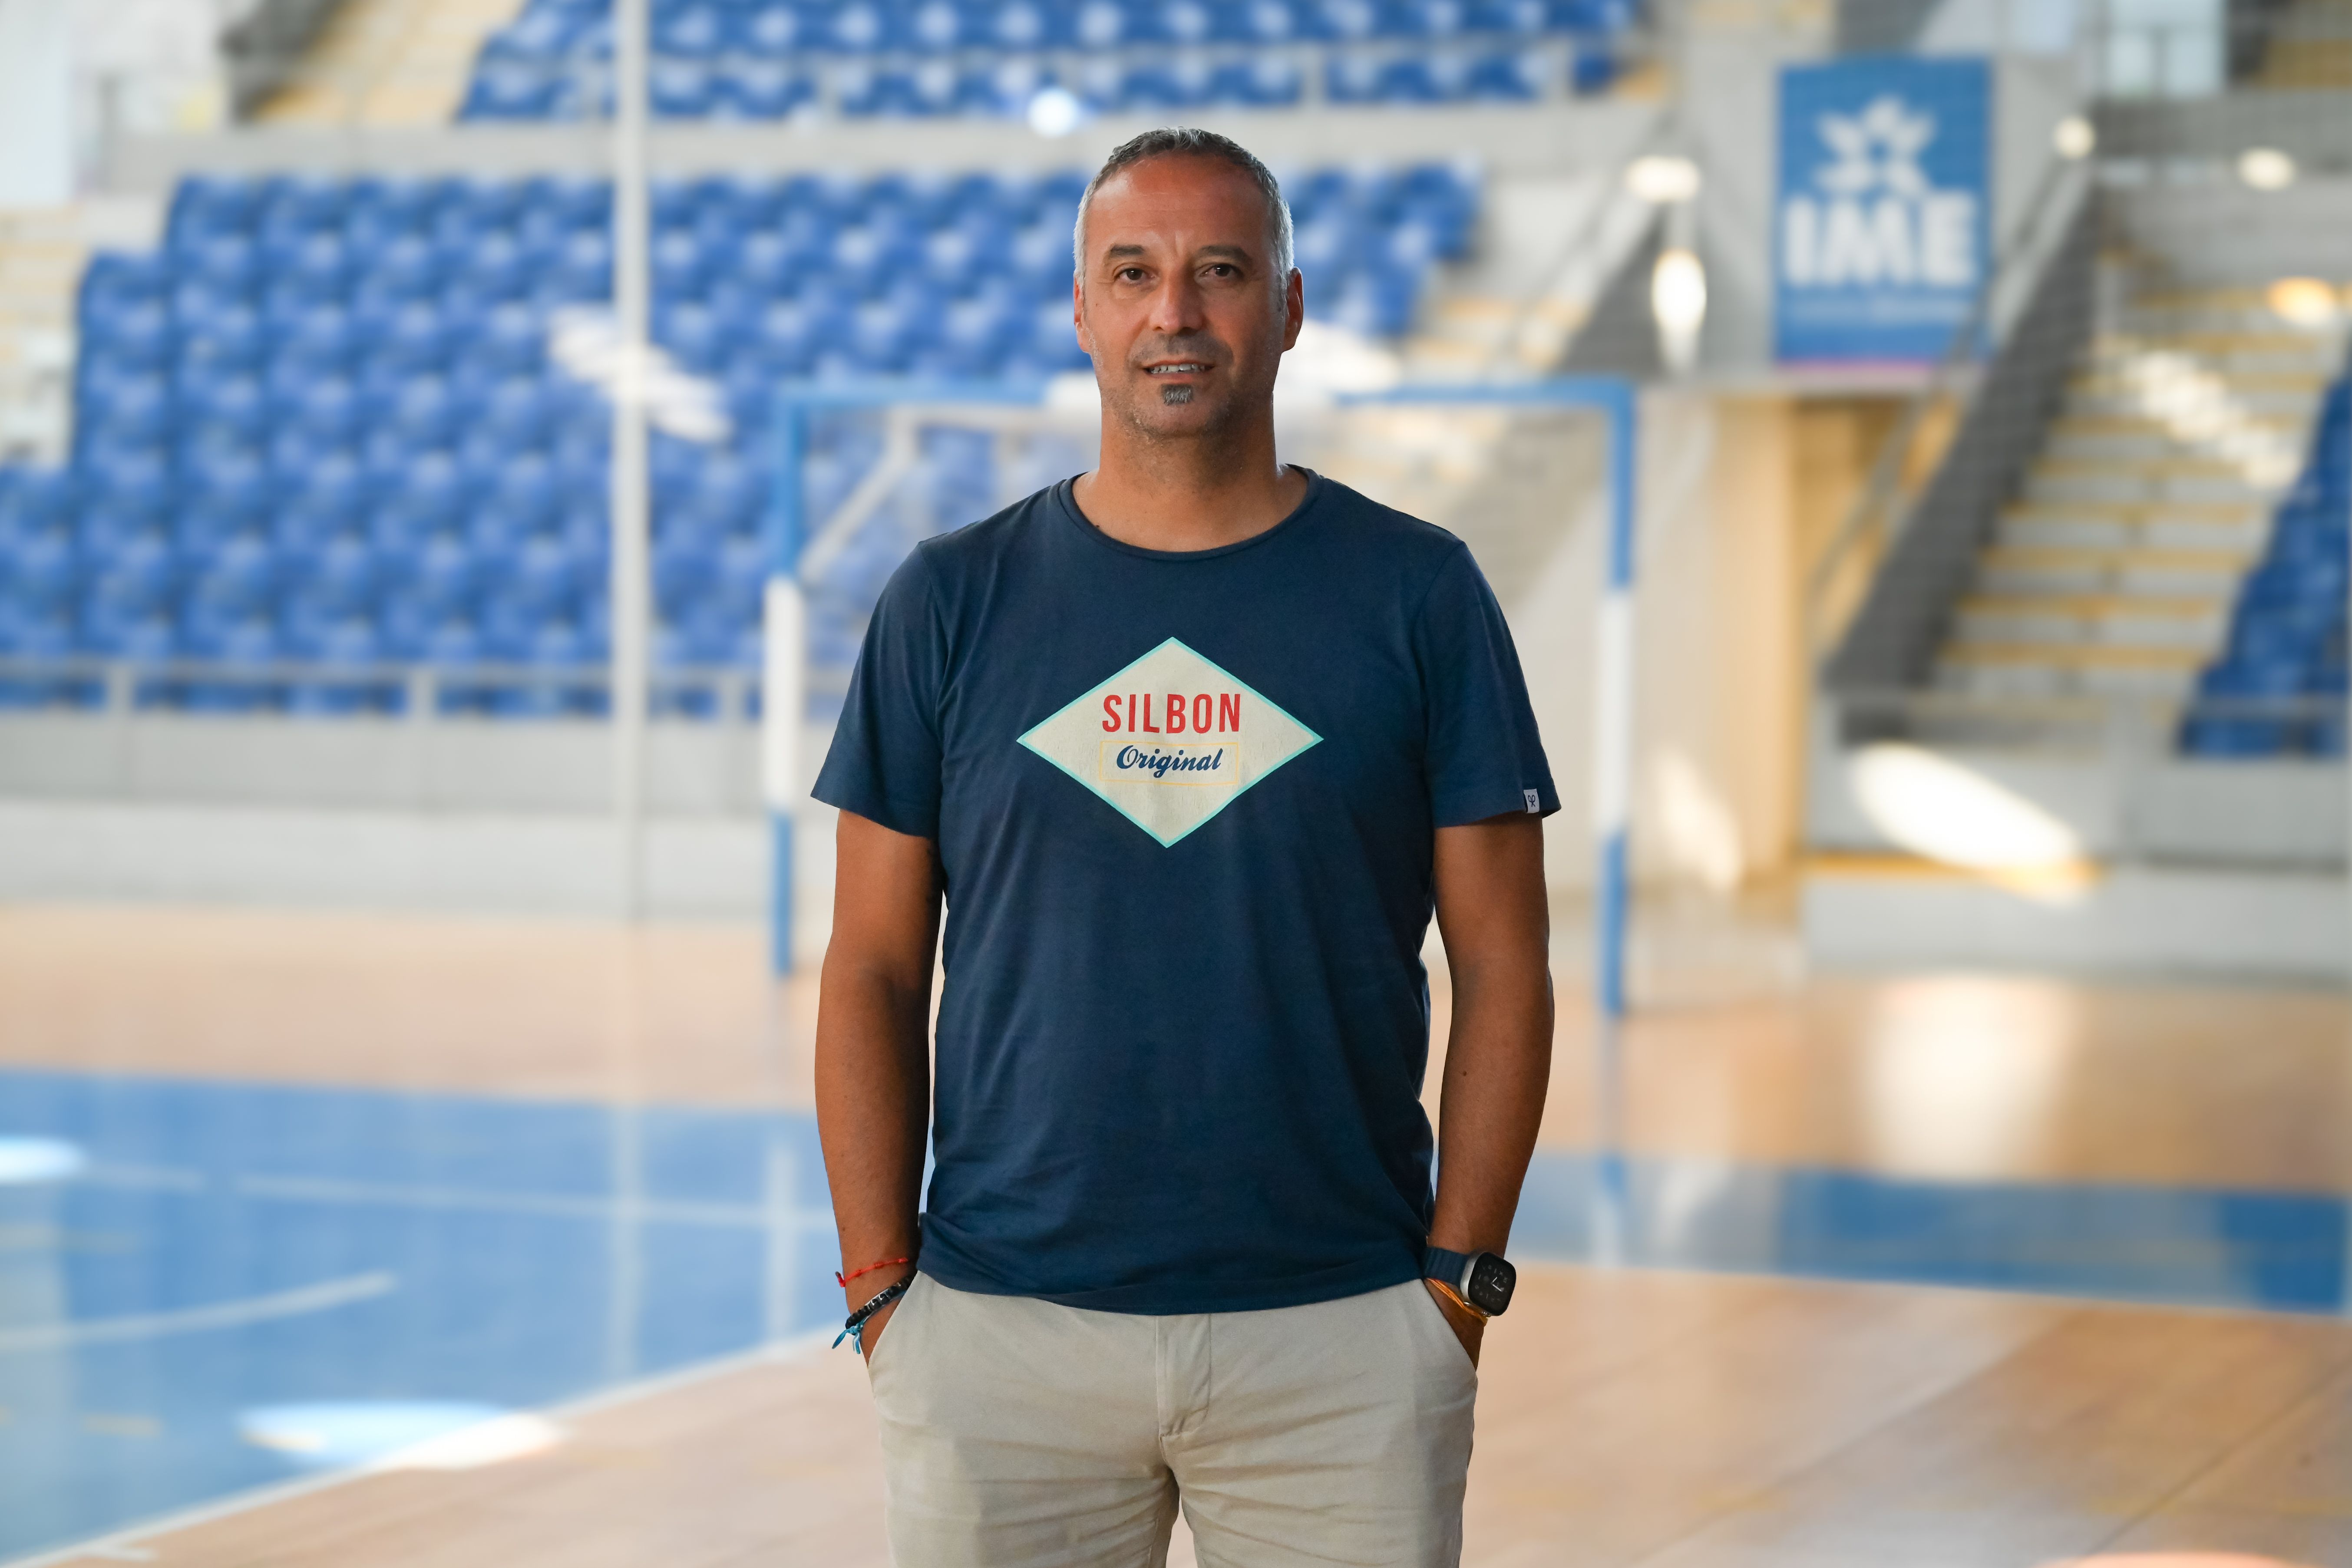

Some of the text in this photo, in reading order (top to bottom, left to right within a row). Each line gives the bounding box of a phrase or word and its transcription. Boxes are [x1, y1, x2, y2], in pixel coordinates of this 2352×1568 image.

[1784, 190, 1975, 287] IME
[1102, 693, 1240, 733] SILBON
[1117, 745, 1223, 778] Original
